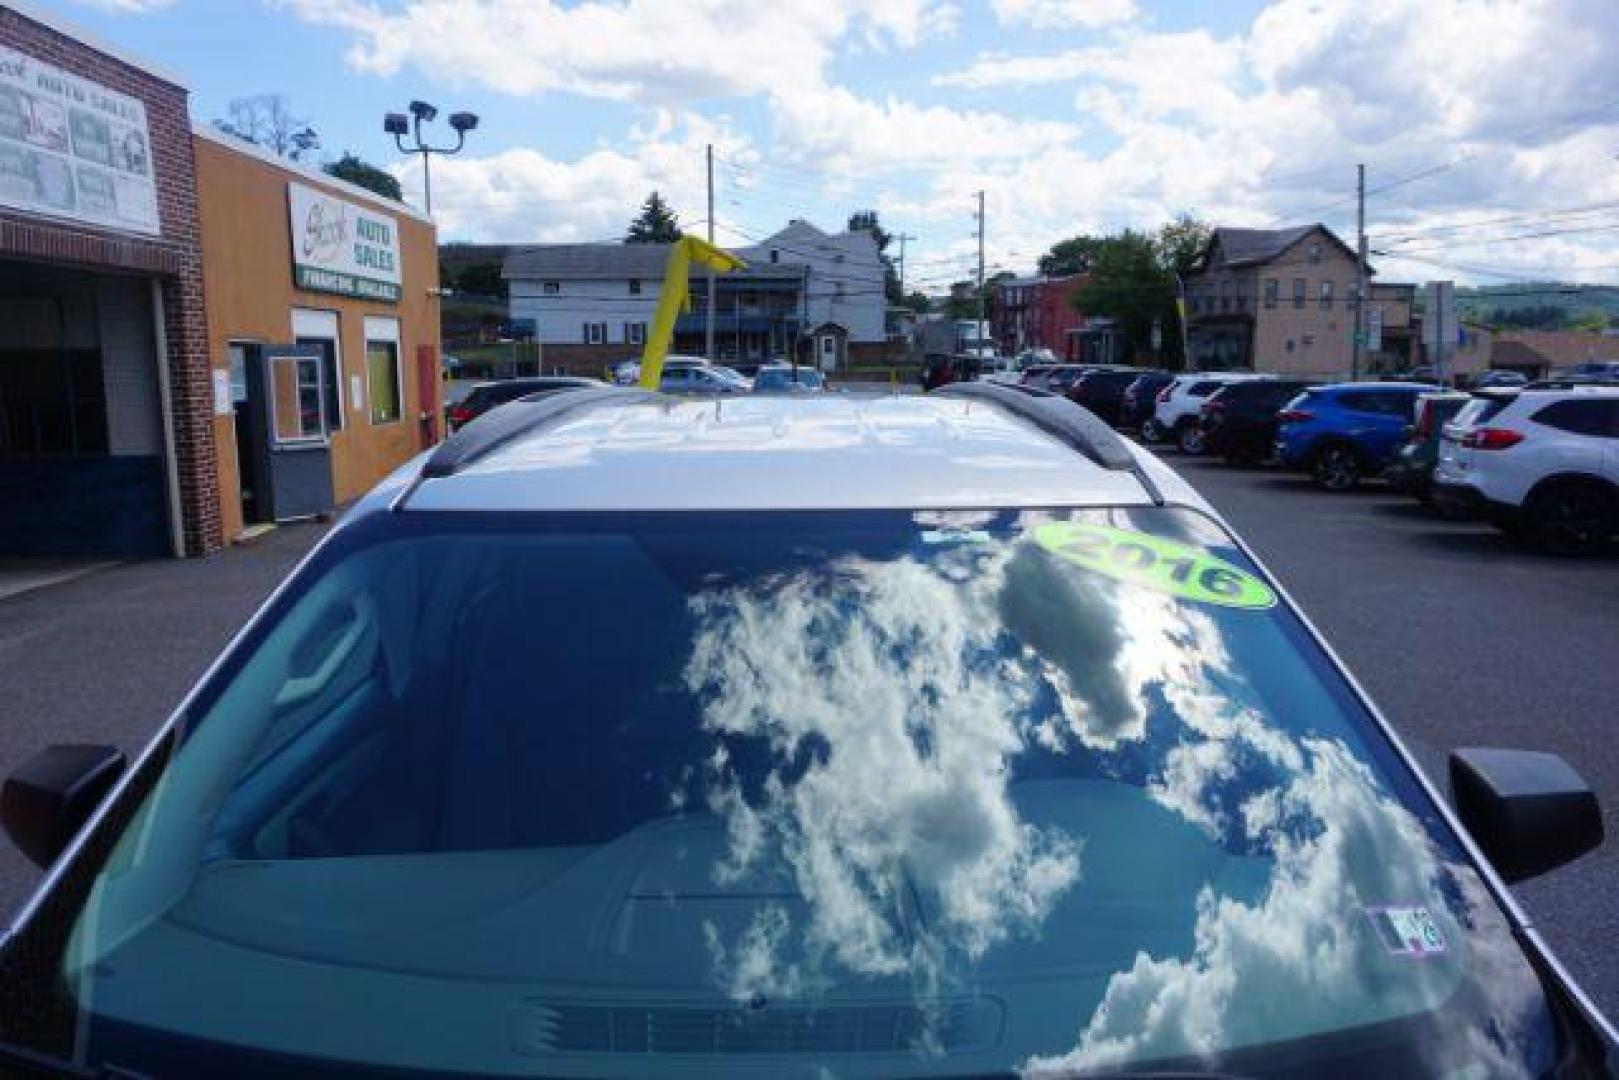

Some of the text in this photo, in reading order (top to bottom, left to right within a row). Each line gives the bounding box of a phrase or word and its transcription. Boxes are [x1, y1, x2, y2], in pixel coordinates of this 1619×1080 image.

[356, 216, 390, 247] AUTO
[353, 243, 395, 272] SALES
[1059, 529, 1243, 598] 2016
